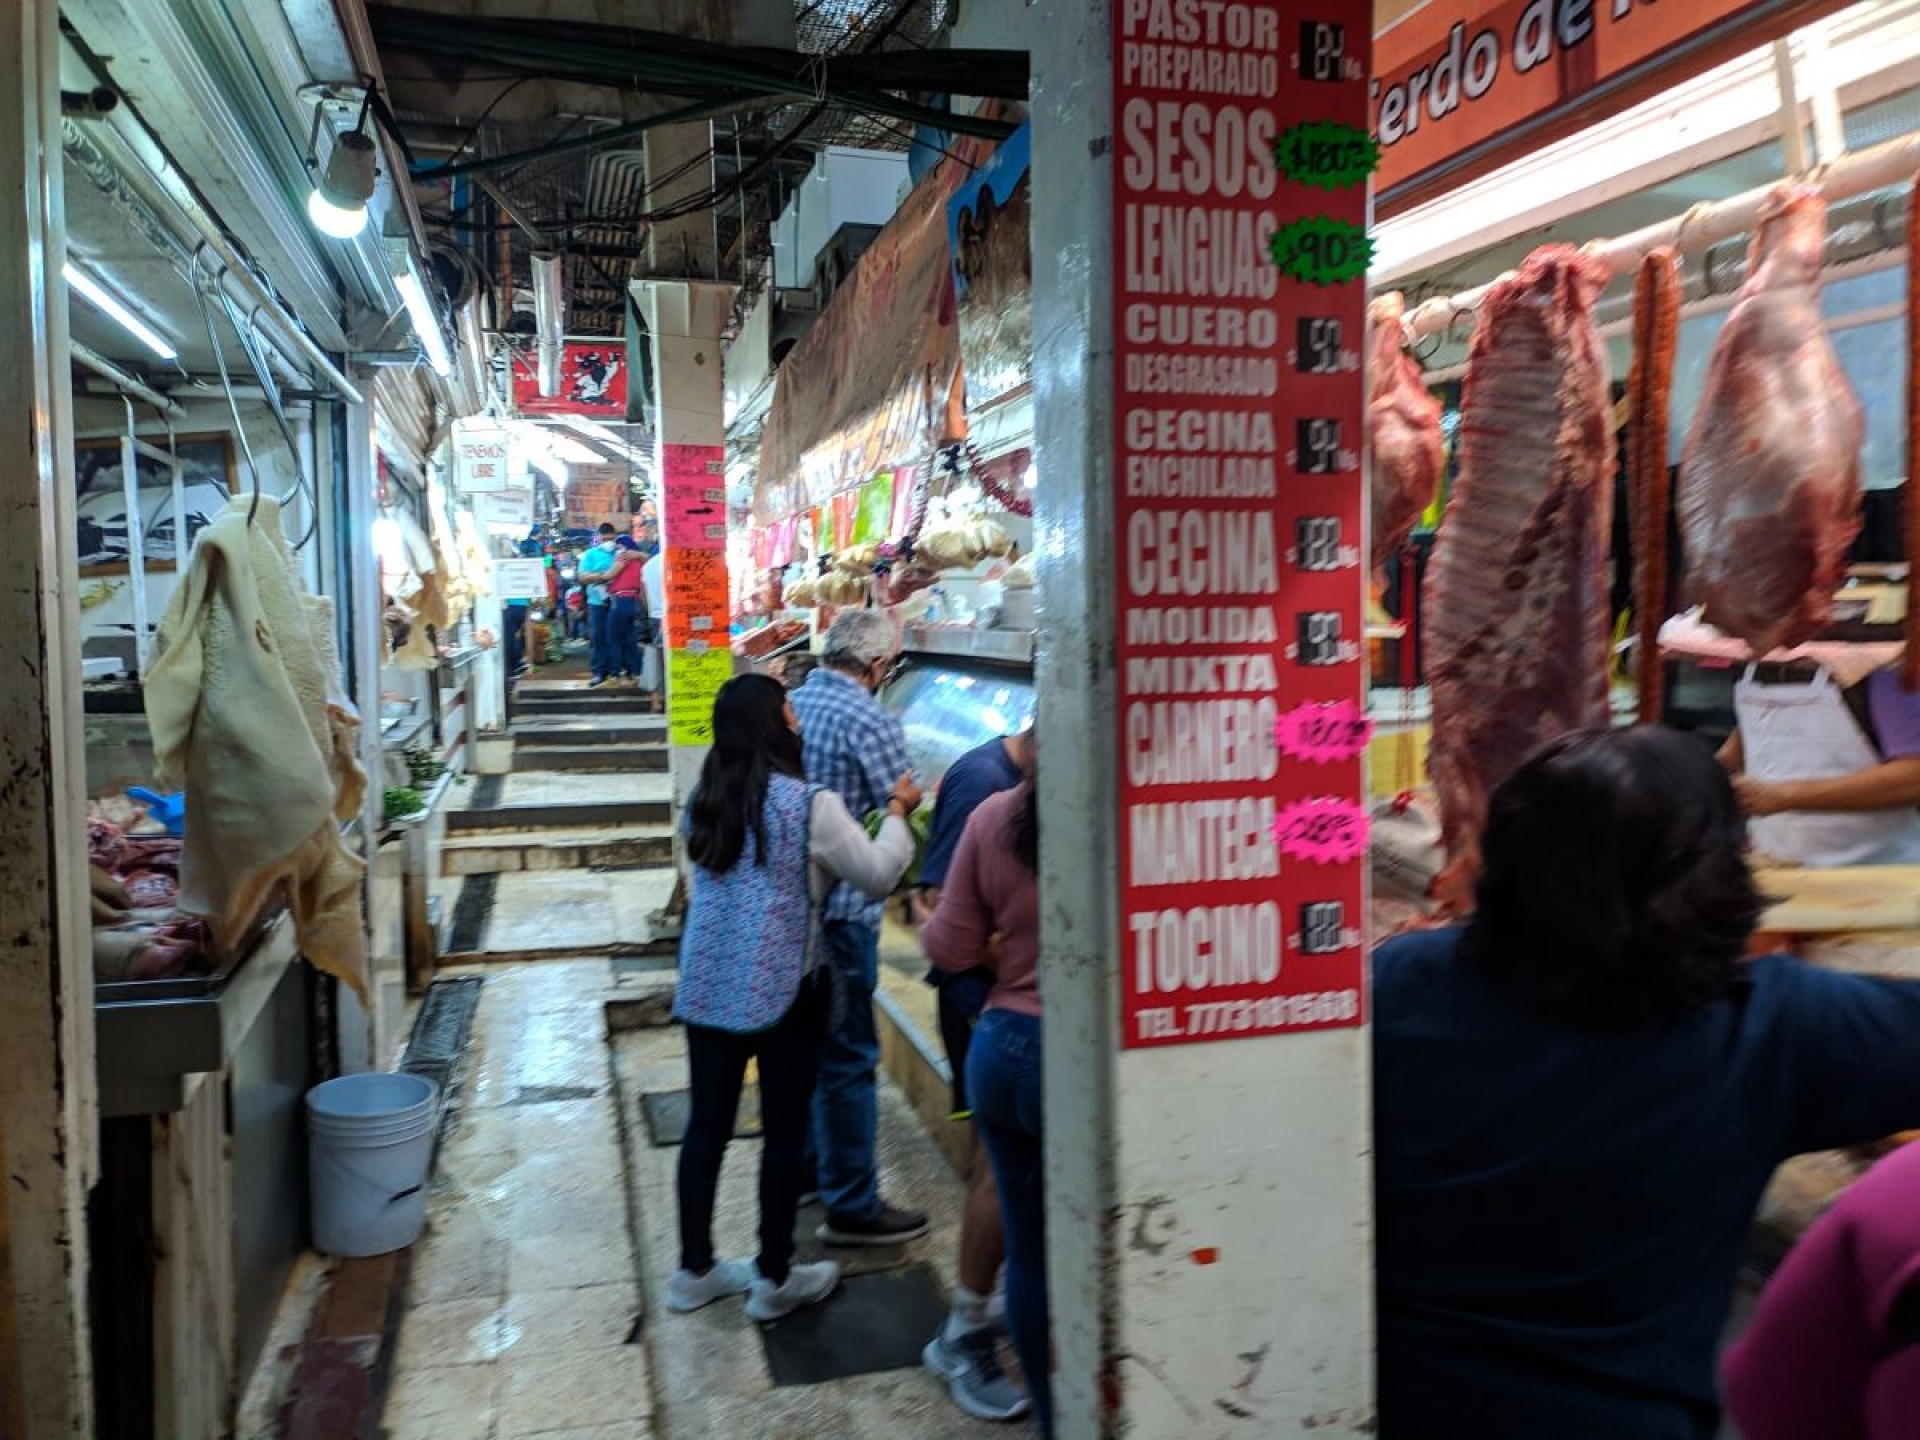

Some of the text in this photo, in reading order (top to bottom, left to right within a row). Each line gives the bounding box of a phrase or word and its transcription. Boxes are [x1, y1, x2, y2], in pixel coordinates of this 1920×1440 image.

[1123, 0, 1278, 50] PASTOR
[1123, 42, 1278, 98] PREPARADO
[1123, 97, 1276, 200] SESOS
[1125, 203, 1278, 300] LENGUAS
[1125, 303, 1278, 349] CUERO
[1126, 353, 1278, 397] DESGRASADO
[1125, 408, 1276, 453] CECINA
[1127, 455, 1277, 498] ENCHILADA
[1127, 508, 1280, 597] CECINA
[1126, 605, 1278, 645] MOLIDA
[1126, 653, 1279, 695] MIXTA
[1127, 696, 1279, 788] CARNERO
[1129, 796, 1281, 888] MANTECA
[1129, 899, 1281, 994] TOCINO
